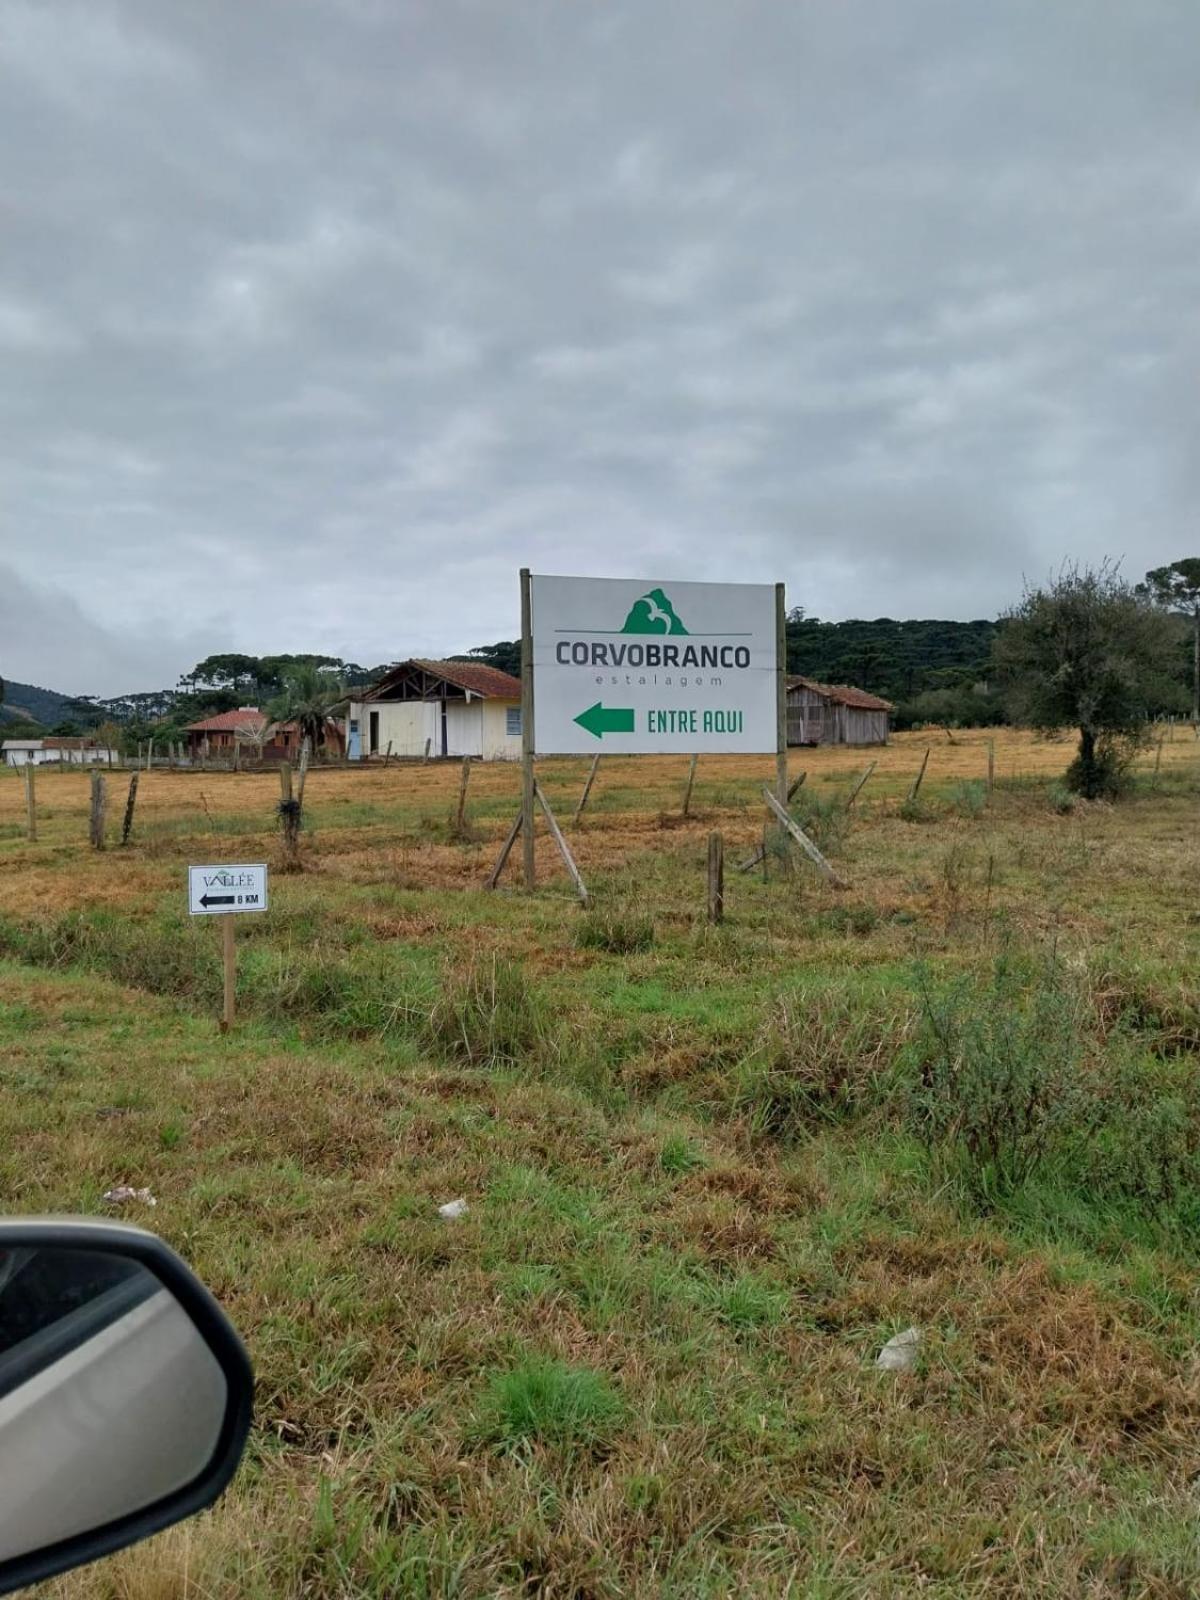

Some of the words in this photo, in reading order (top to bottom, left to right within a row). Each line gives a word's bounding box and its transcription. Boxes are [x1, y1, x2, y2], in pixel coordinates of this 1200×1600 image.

[556, 641, 750, 669] CORVOBRANCO
[595, 674, 722, 687] estalagem
[647, 710, 697, 734] ENTRE
[703, 710, 743, 734] AQUI
[203, 872, 255, 887] VALLÉE
[245, 894, 259, 904] KM
